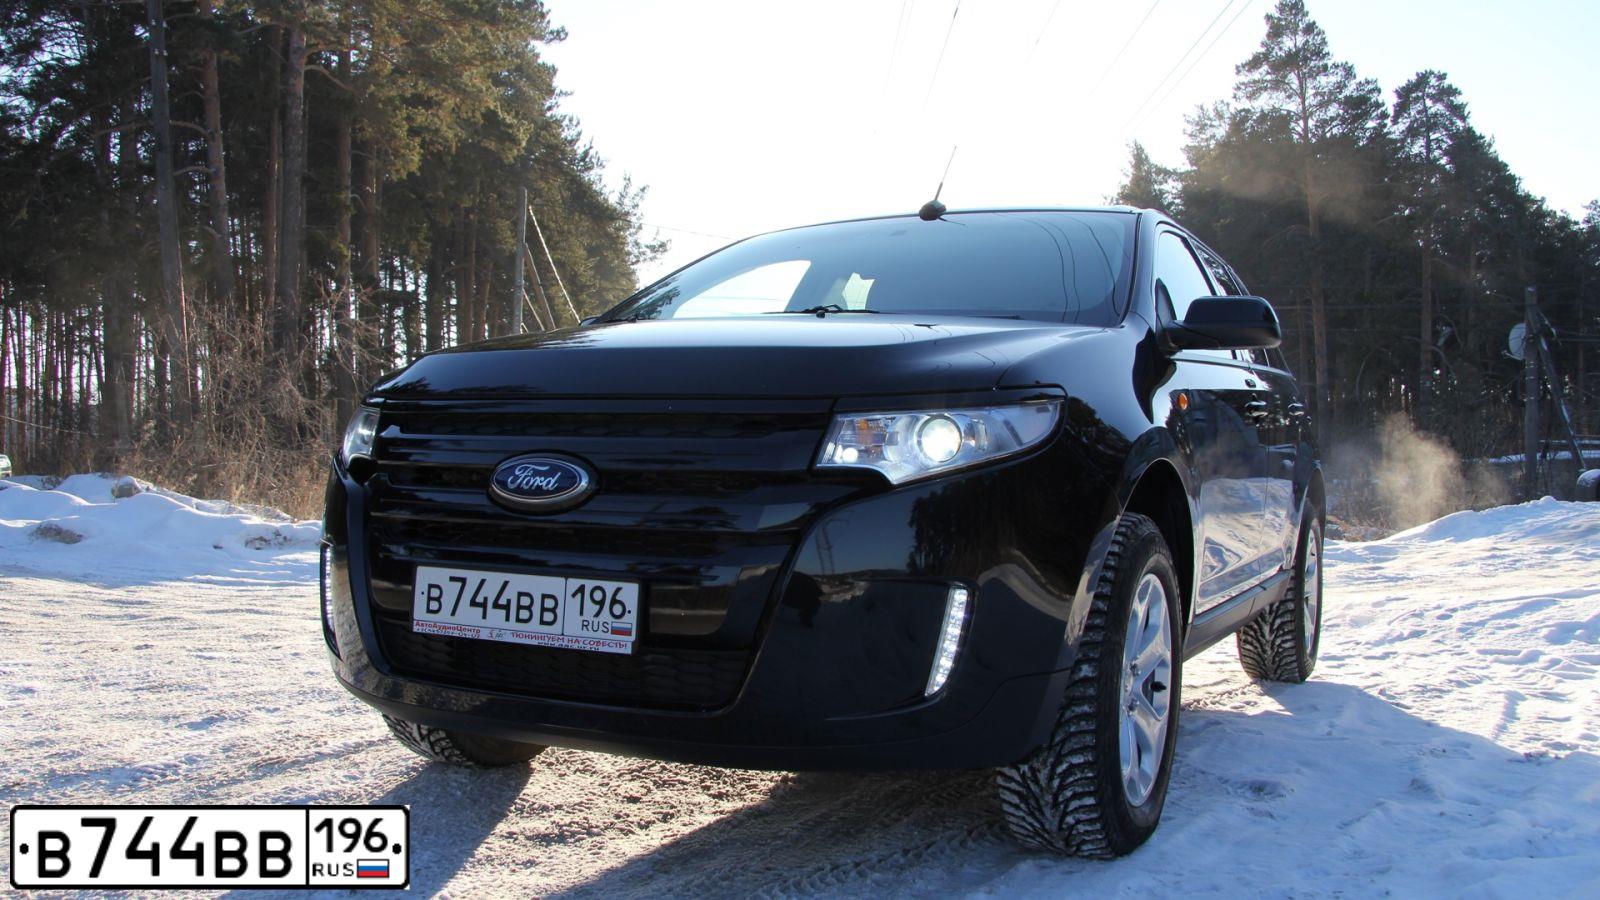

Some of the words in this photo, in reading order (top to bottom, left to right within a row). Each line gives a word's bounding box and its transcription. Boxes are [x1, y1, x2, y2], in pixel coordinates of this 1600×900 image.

[507, 463, 562, 491] Ford
[570, 584, 627, 620] 196
[581, 619, 610, 633] RUS
[567, 637, 581, 646] НА
